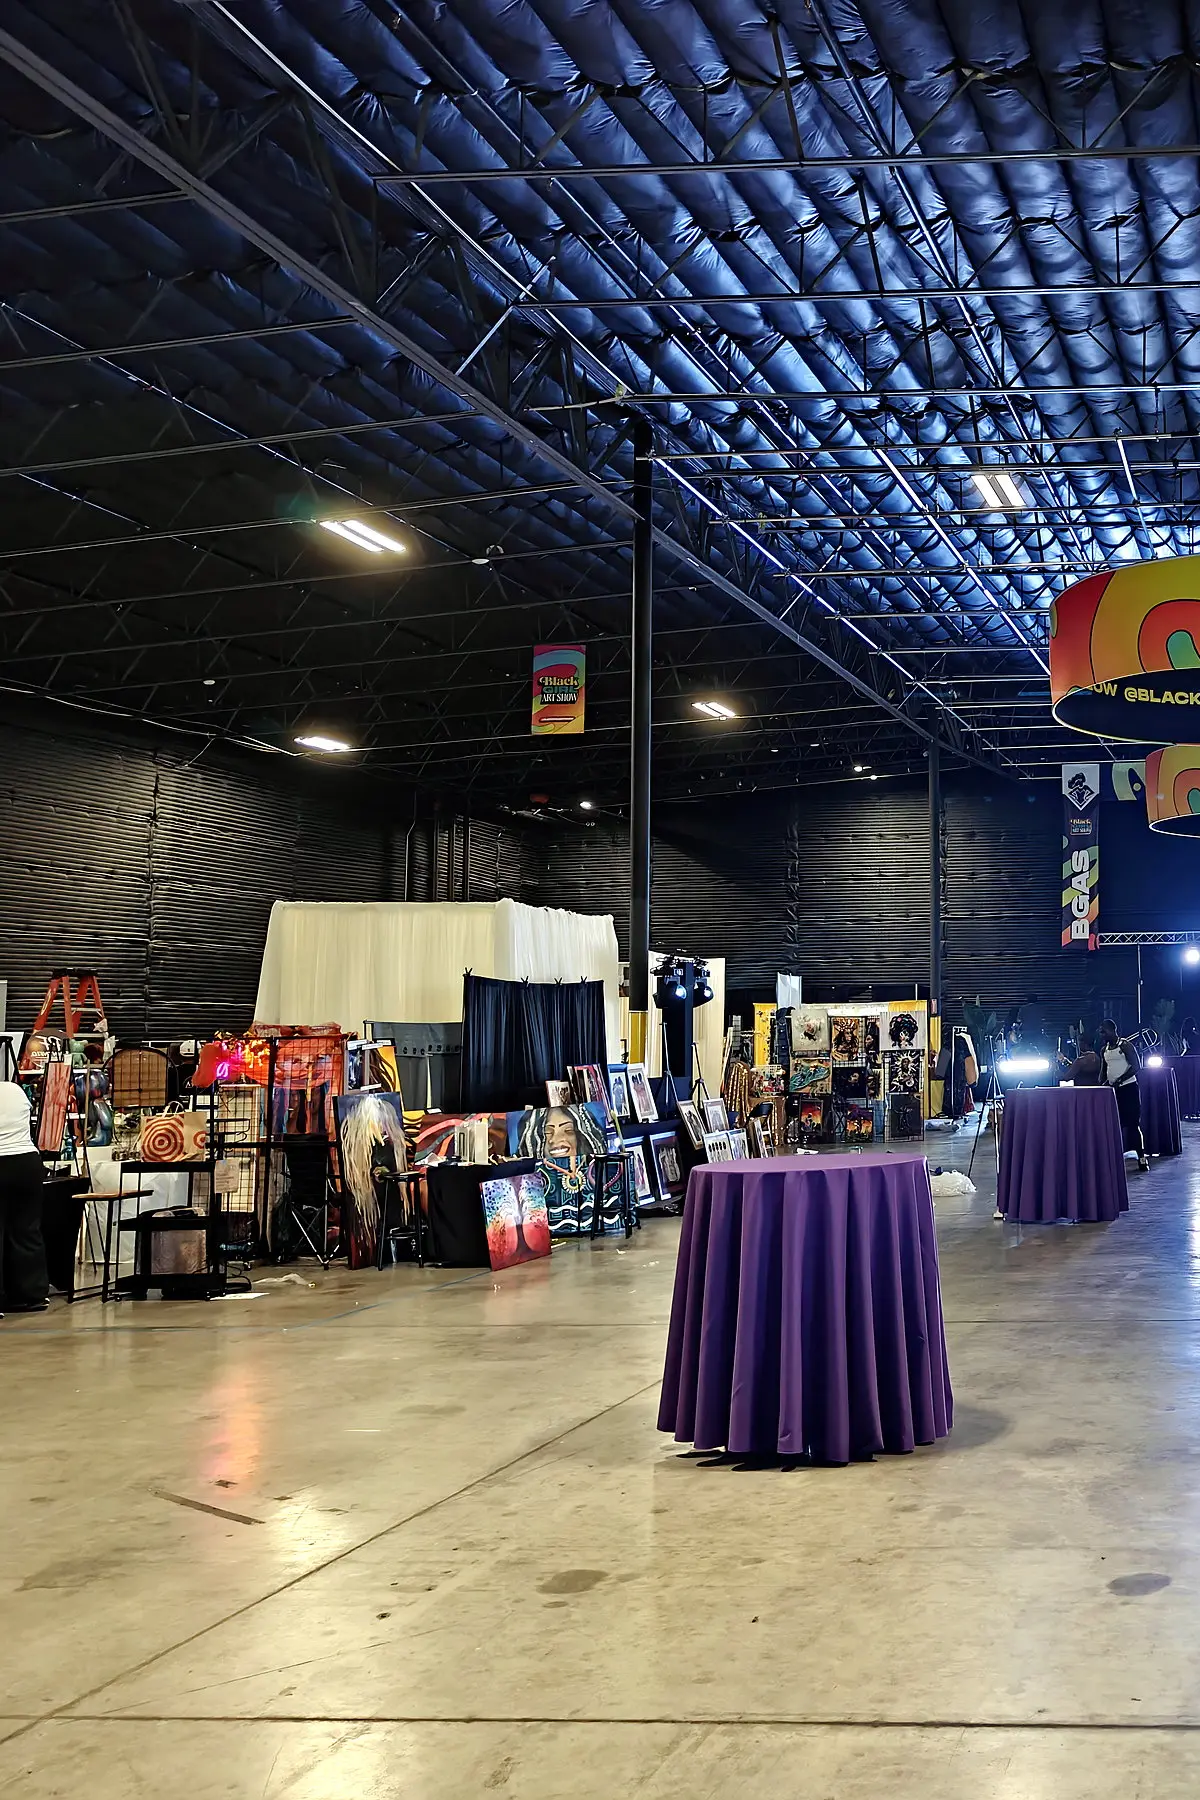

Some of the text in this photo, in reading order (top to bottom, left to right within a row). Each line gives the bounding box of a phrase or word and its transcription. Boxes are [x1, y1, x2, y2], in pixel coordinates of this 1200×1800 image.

[540, 676, 578, 686] Black
[542, 685, 578, 694] GIRL
[541, 693, 579, 702] ART SHOW
[1071, 849, 1090, 940] BGAS
